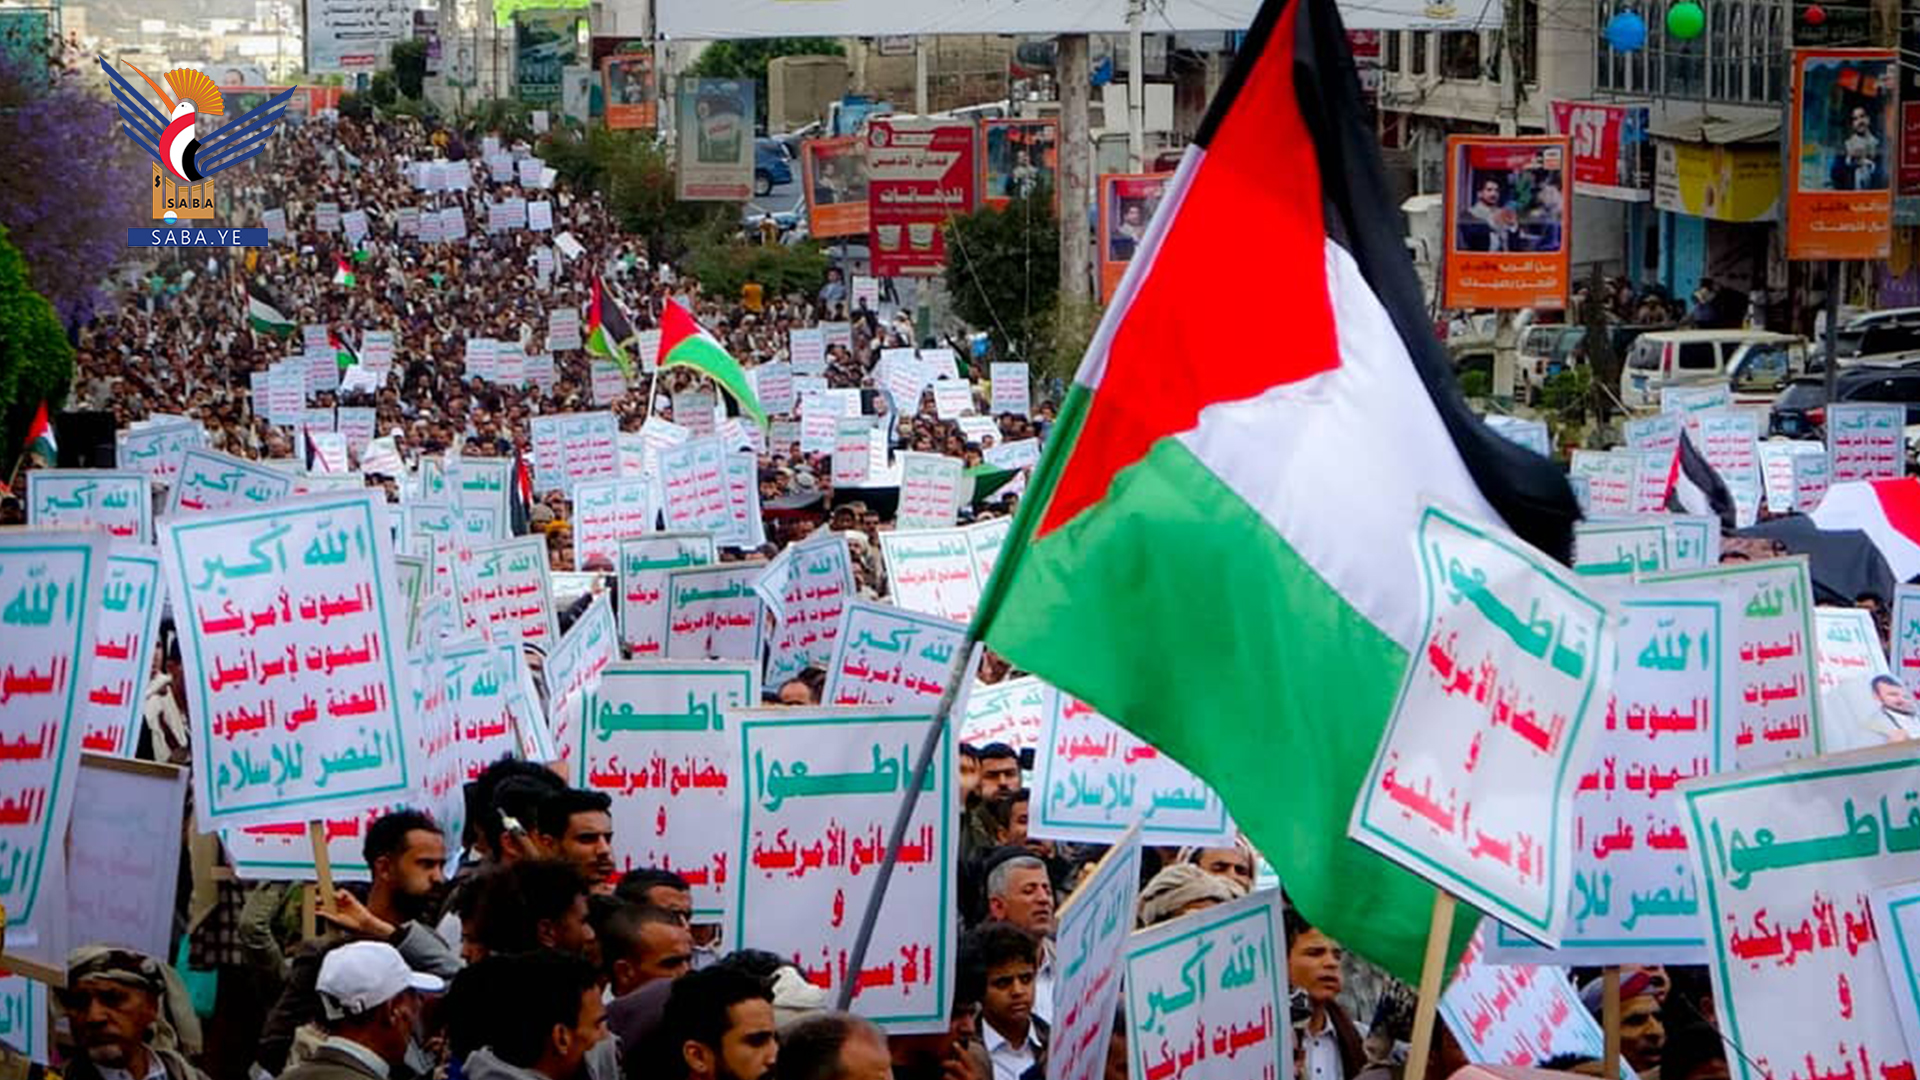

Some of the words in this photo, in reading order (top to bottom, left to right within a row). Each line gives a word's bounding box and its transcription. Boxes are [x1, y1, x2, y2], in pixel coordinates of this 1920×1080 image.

[40, 481, 98, 517] أكبر
[101, 484, 138, 508] الله
[186, 466, 246, 494] أكبر
[193, 518, 293, 597] أكبر
[302, 513, 367, 567] الله
[2, 562, 75, 626] الله
[198, 584, 293, 637] لأمريكا
[300, 581, 374, 627] الموت
[1432, 541, 1588, 681] قاطعوا
[1743, 576, 1798, 619] الله
[305, 631, 381, 679] الموت
[850, 622, 923, 656] أكبر
[1427, 615, 1498, 708] الأمريكية
[1637, 616, 1709, 672] الله
[1739, 630, 1802, 667] الموت
[208, 641, 300, 693] لإسرائيل
[842, 656, 903, 684] لأمريكا
[1743, 672, 1806, 708] الموت
[211, 698, 276, 742] اليهود
[284, 703, 319, 733] على
[327, 681, 388, 720] اللعنة
[1489, 678, 1567, 758] البضائع
[1625, 697, 1709, 741] الموت
[1057, 732, 1119, 765] اليهود
[1762, 713, 1810, 742] اللعنة
[216, 740, 304, 799] للإسلام
[313, 724, 395, 789] النصر
[589, 749, 667, 796] الأمريكية
[1464, 730, 1482, 774] و
[1052, 769, 1137, 822] للإسلام
[1381, 749, 1544, 888] الإسرائيلية
[655, 804, 667, 837] و
[1592, 816, 1634, 860] على
[752, 817, 847, 879] الأمريكية
[830, 888, 845, 928] و
[1727, 889, 1841, 970] الأمريكية
[1219, 932, 1269, 990] الله
[1138, 937, 1215, 1037] أكبر
[1837, 972, 1853, 1021] و
[1212, 1003, 1274, 1060] الموت
